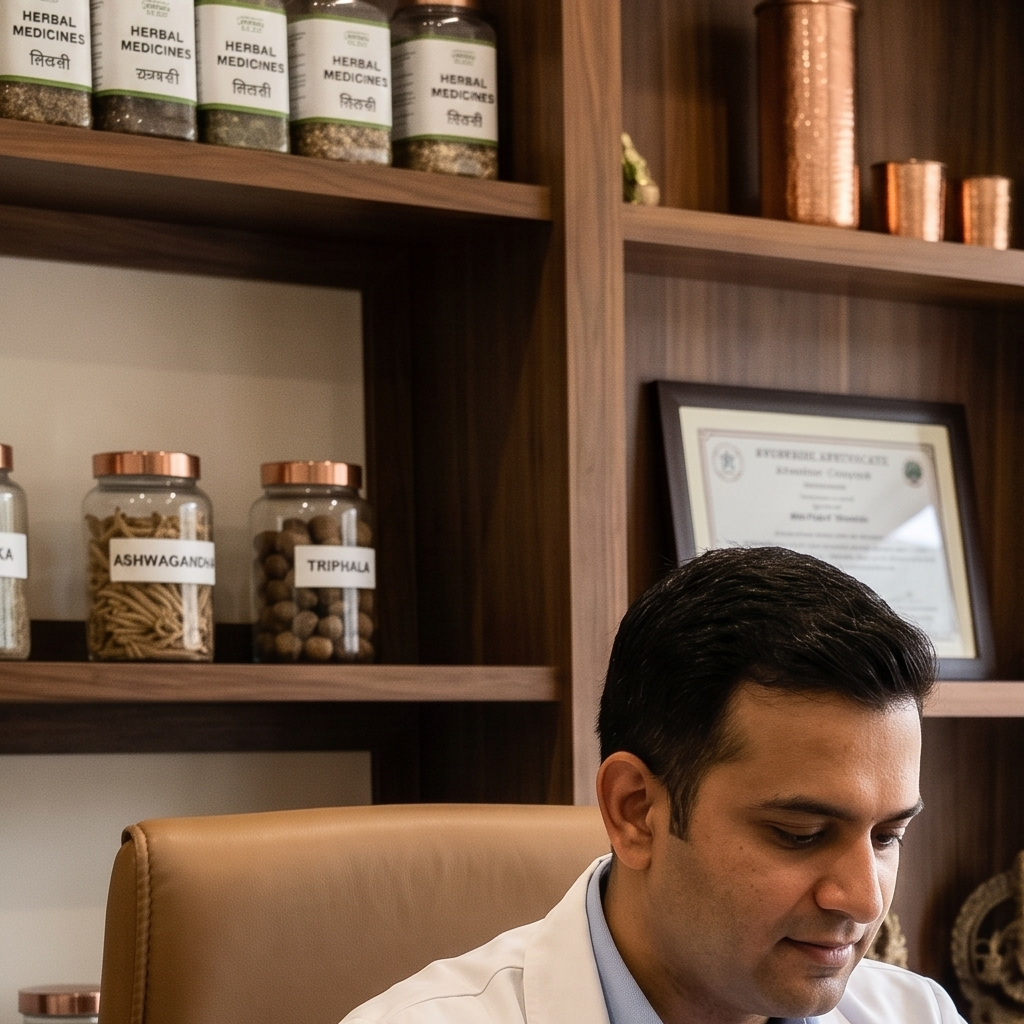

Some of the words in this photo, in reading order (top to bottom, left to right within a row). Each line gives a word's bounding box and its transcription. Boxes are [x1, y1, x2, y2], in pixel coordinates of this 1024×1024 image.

[22, 10, 76, 28] HERBAL
[13, 25, 85, 45] MEDICINES
[130, 25, 184, 43] HERBAL
[121, 39, 192, 60] MEDICINES
[225, 40, 277, 58] HERBAL
[217, 55, 285, 74] MEDICINES
[332, 55, 382, 72] HERBAL
[323, 69, 389, 88] MEDICINES
[440, 73, 488, 89] HERBAL
[430, 87, 496, 105] MEDICINES
[307, 559, 371, 574] TRIPHALA
